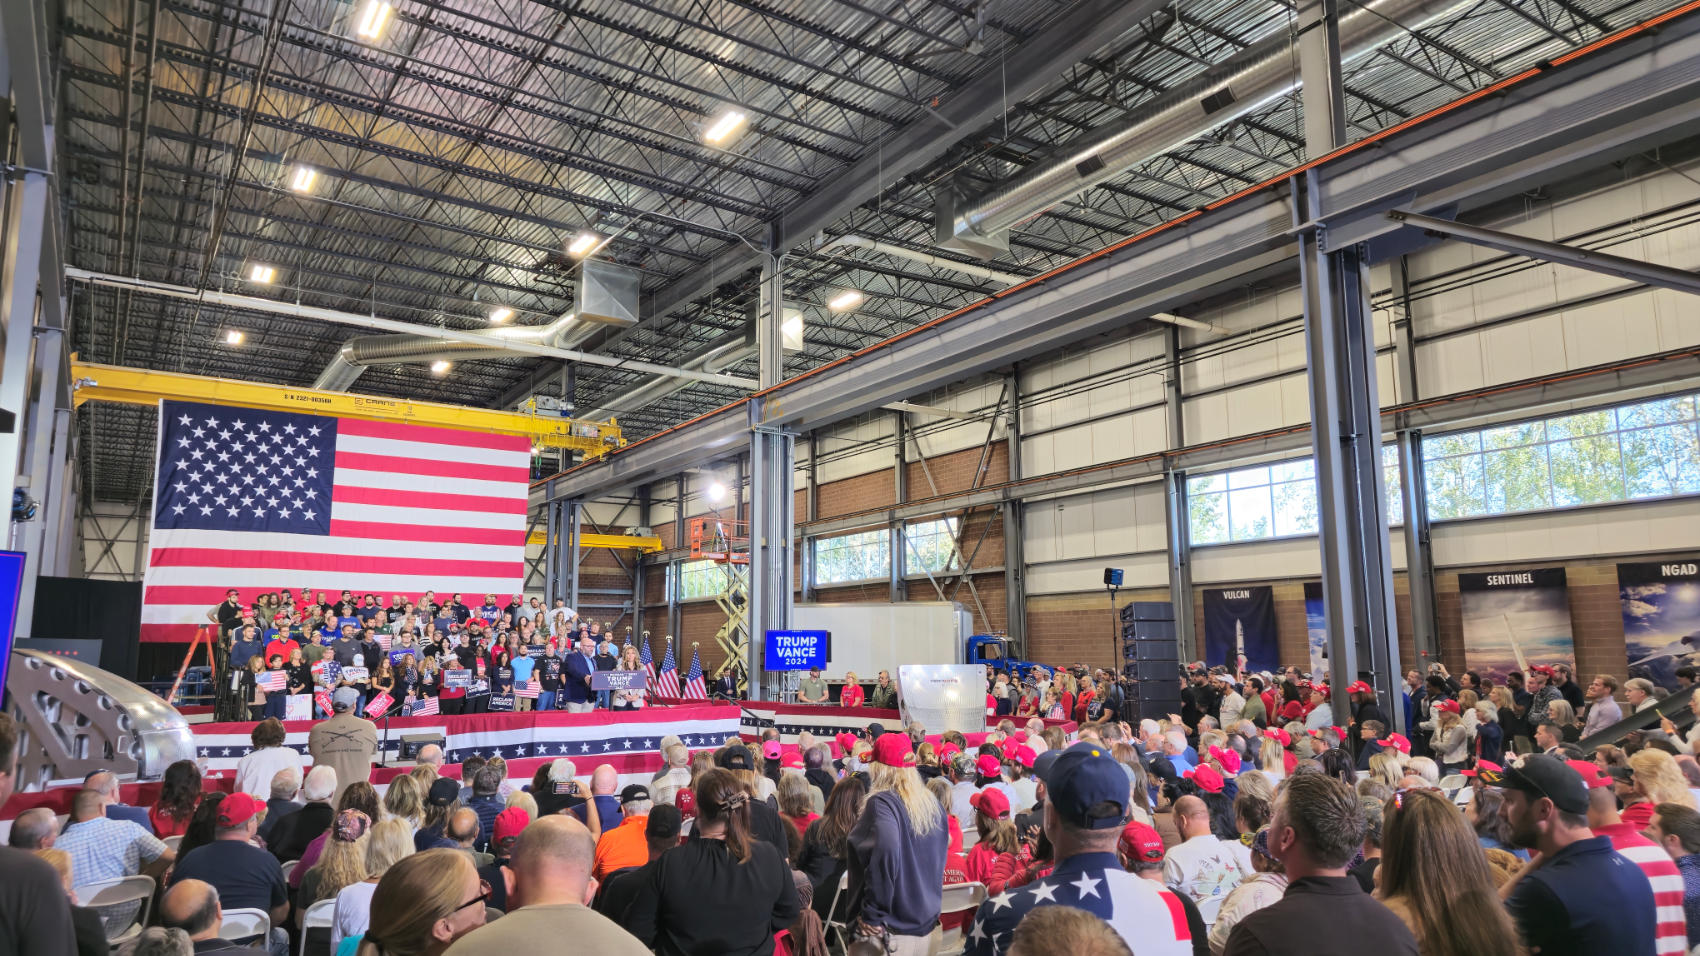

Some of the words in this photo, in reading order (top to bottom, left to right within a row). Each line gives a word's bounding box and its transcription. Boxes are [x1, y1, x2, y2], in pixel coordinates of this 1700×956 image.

[1661, 563, 1697, 577] NGAD
[1486, 573, 1534, 586] SENTINEL
[1223, 590, 1250, 600] VULCAN
[775, 636, 818, 647] TRUMP
[776, 647, 816, 657] VANCE
[785, 657, 807, 665] 2024
